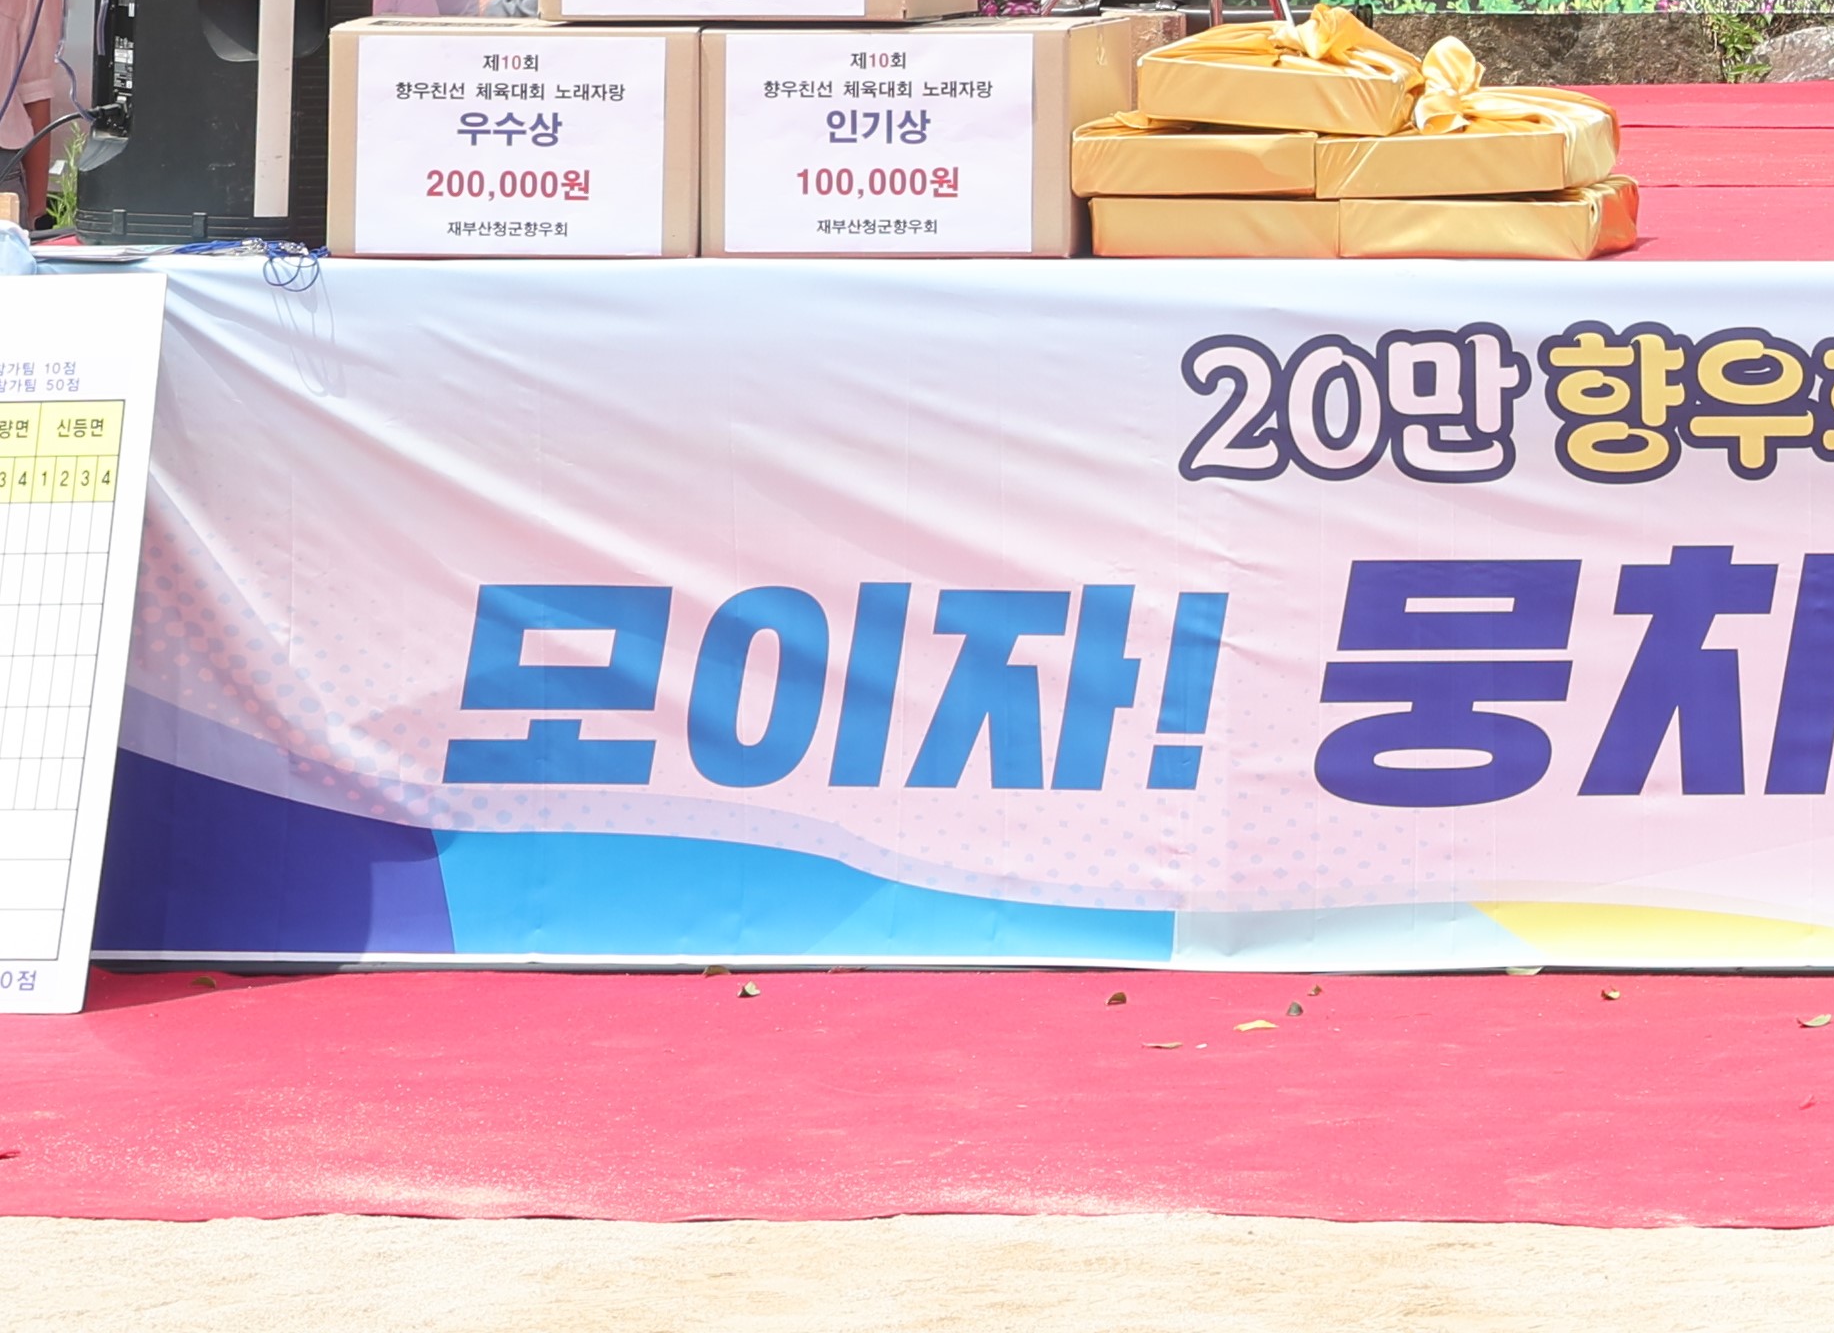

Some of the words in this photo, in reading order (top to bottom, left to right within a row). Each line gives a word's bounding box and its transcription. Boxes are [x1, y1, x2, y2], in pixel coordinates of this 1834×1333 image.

[483, 54, 538, 72] 제10회
[850, 52, 906, 69] 제10회
[396, 82, 464, 99] 향우친선
[476, 83, 544, 100] 체육대회
[555, 84, 625, 101] 노래자랑
[764, 81, 832, 98] 향우친선
[844, 81, 912, 98] 체육대회
[922, 81, 993, 98] 노래자랑
[457, 112, 562, 147] 우수상
[827, 109, 931, 144] 인기상
[427, 170, 590, 201] 200,000원
[797, 167, 958, 199] 100,000원
[448, 221, 567, 237] 재부산청군향우회
[817, 219, 937, 234] 재부산청군향우회
[45, 362, 76, 375] 10점
[46, 378, 80, 392] 50점
[1190, 335, 1517, 474] 20만
[57, 418, 104, 438] 신등면
[18, 471, 27, 486] 4
[41, 471, 47, 486] 1
[60, 470, 69, 486] 2
[81, 470, 90, 486] 3
[102, 470, 111, 485] 4
[442, 581, 1230, 791] 모이자!
